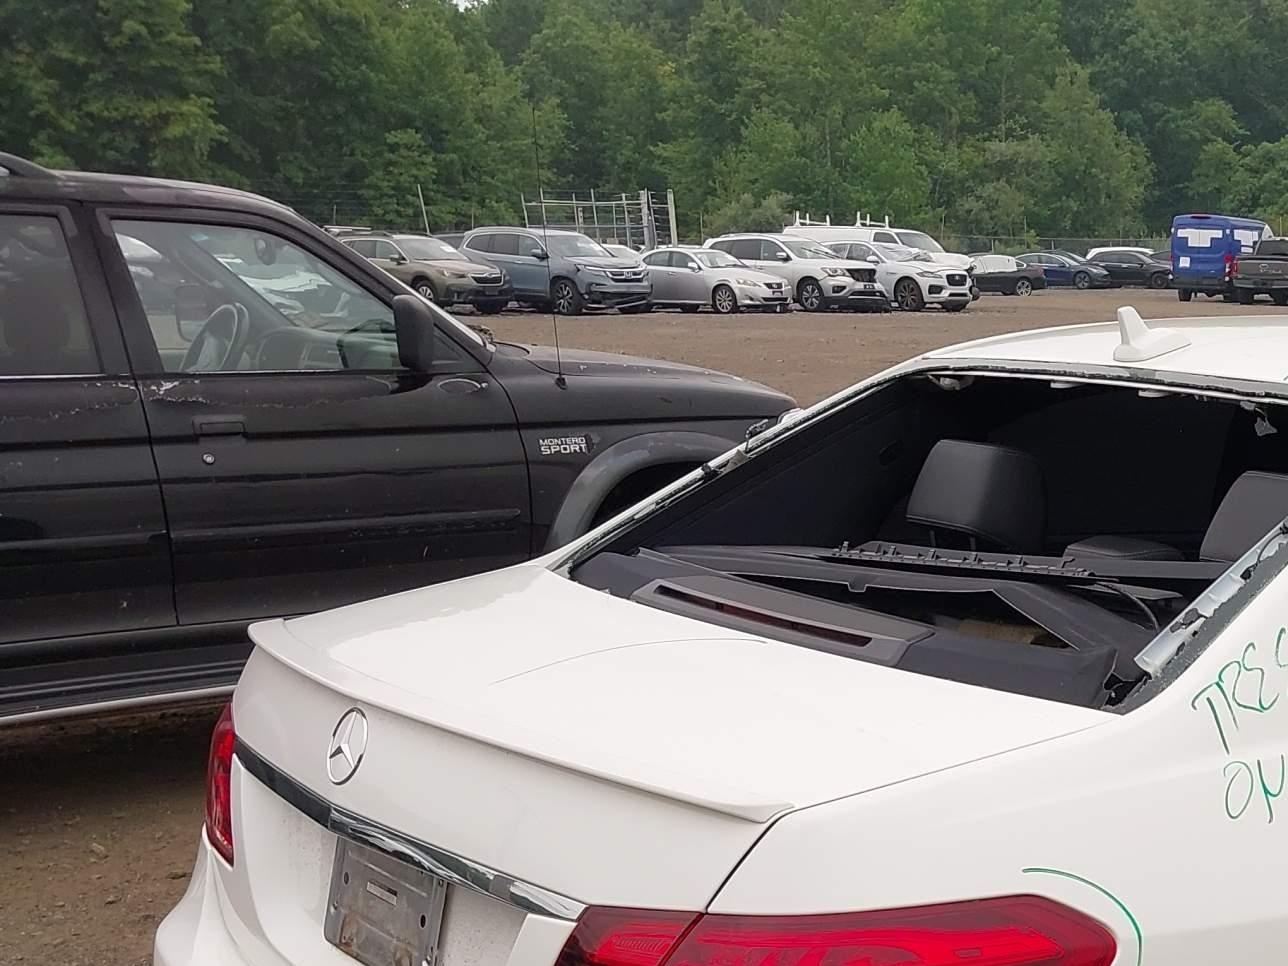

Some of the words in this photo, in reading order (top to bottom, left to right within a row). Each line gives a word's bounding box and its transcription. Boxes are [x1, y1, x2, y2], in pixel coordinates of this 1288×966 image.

[539, 436, 586, 446] MONTERO
[540, 444, 587, 455] SPORT
[1223, 754, 1285, 824] ON
